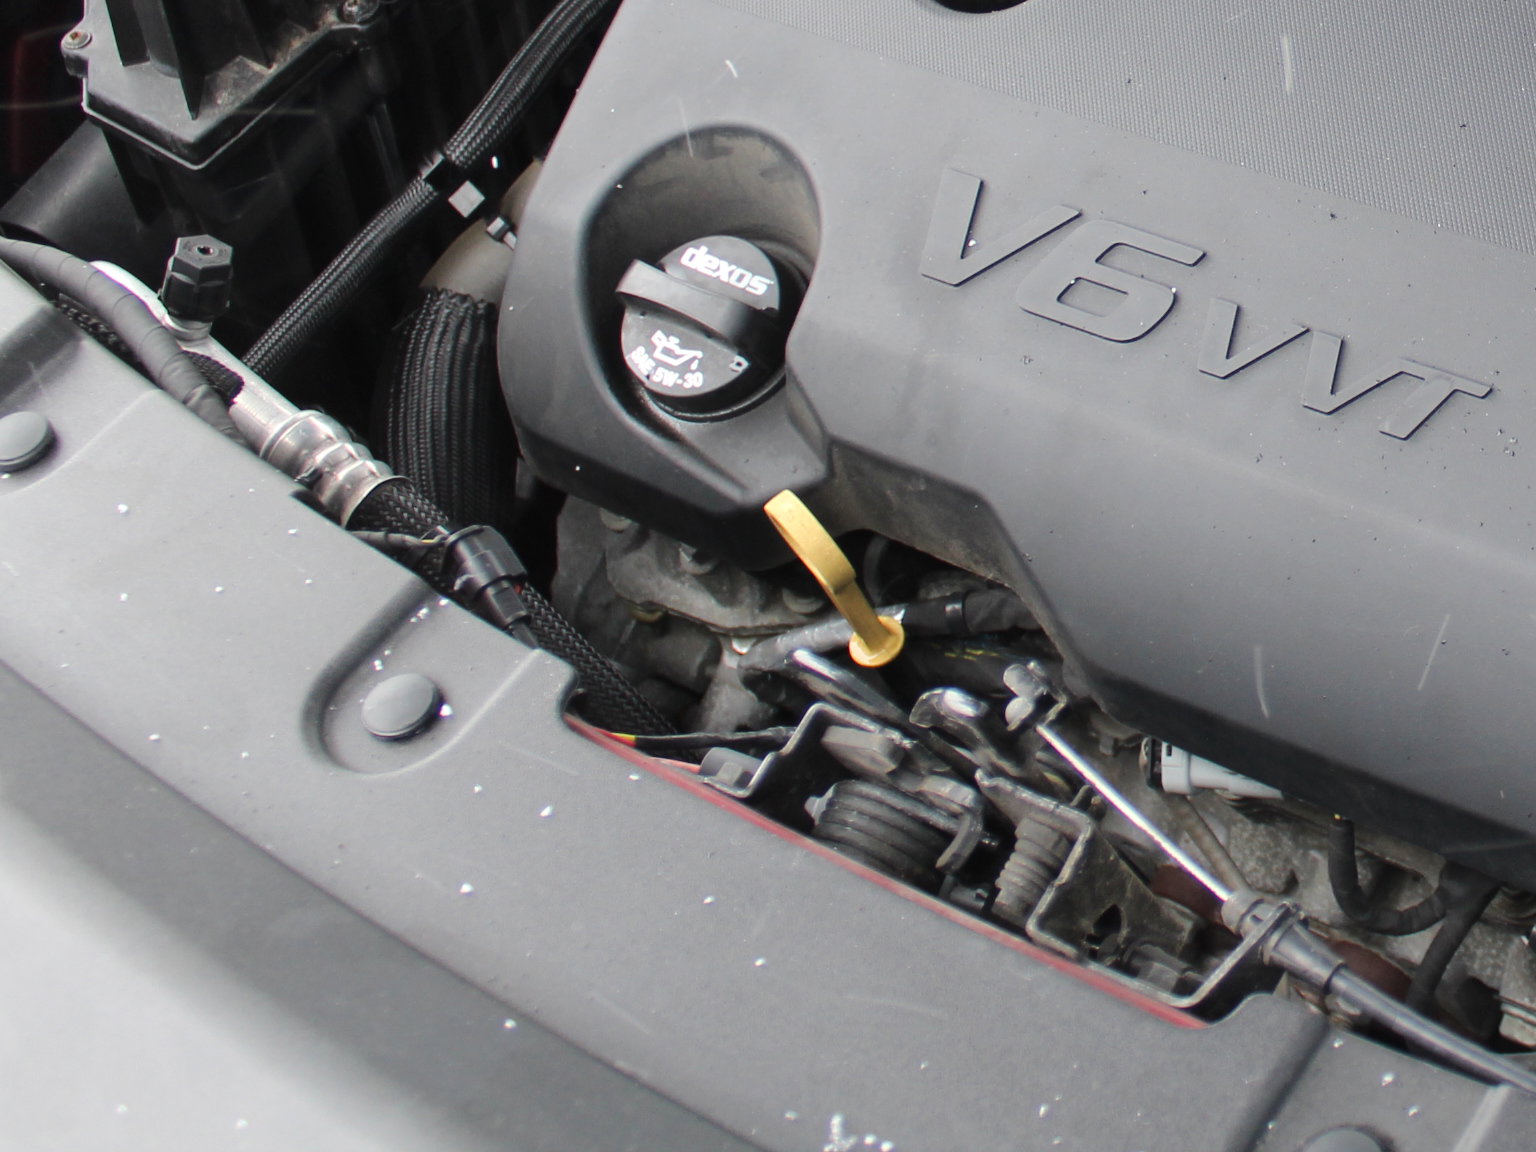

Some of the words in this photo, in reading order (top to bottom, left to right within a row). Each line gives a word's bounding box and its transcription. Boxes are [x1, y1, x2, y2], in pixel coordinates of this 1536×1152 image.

[630, 346, 655, 377] SAE
[652, 369, 703, 389] 5W-30
[919, 167, 1207, 343] V6
[1198, 296, 1494, 441] VVT
